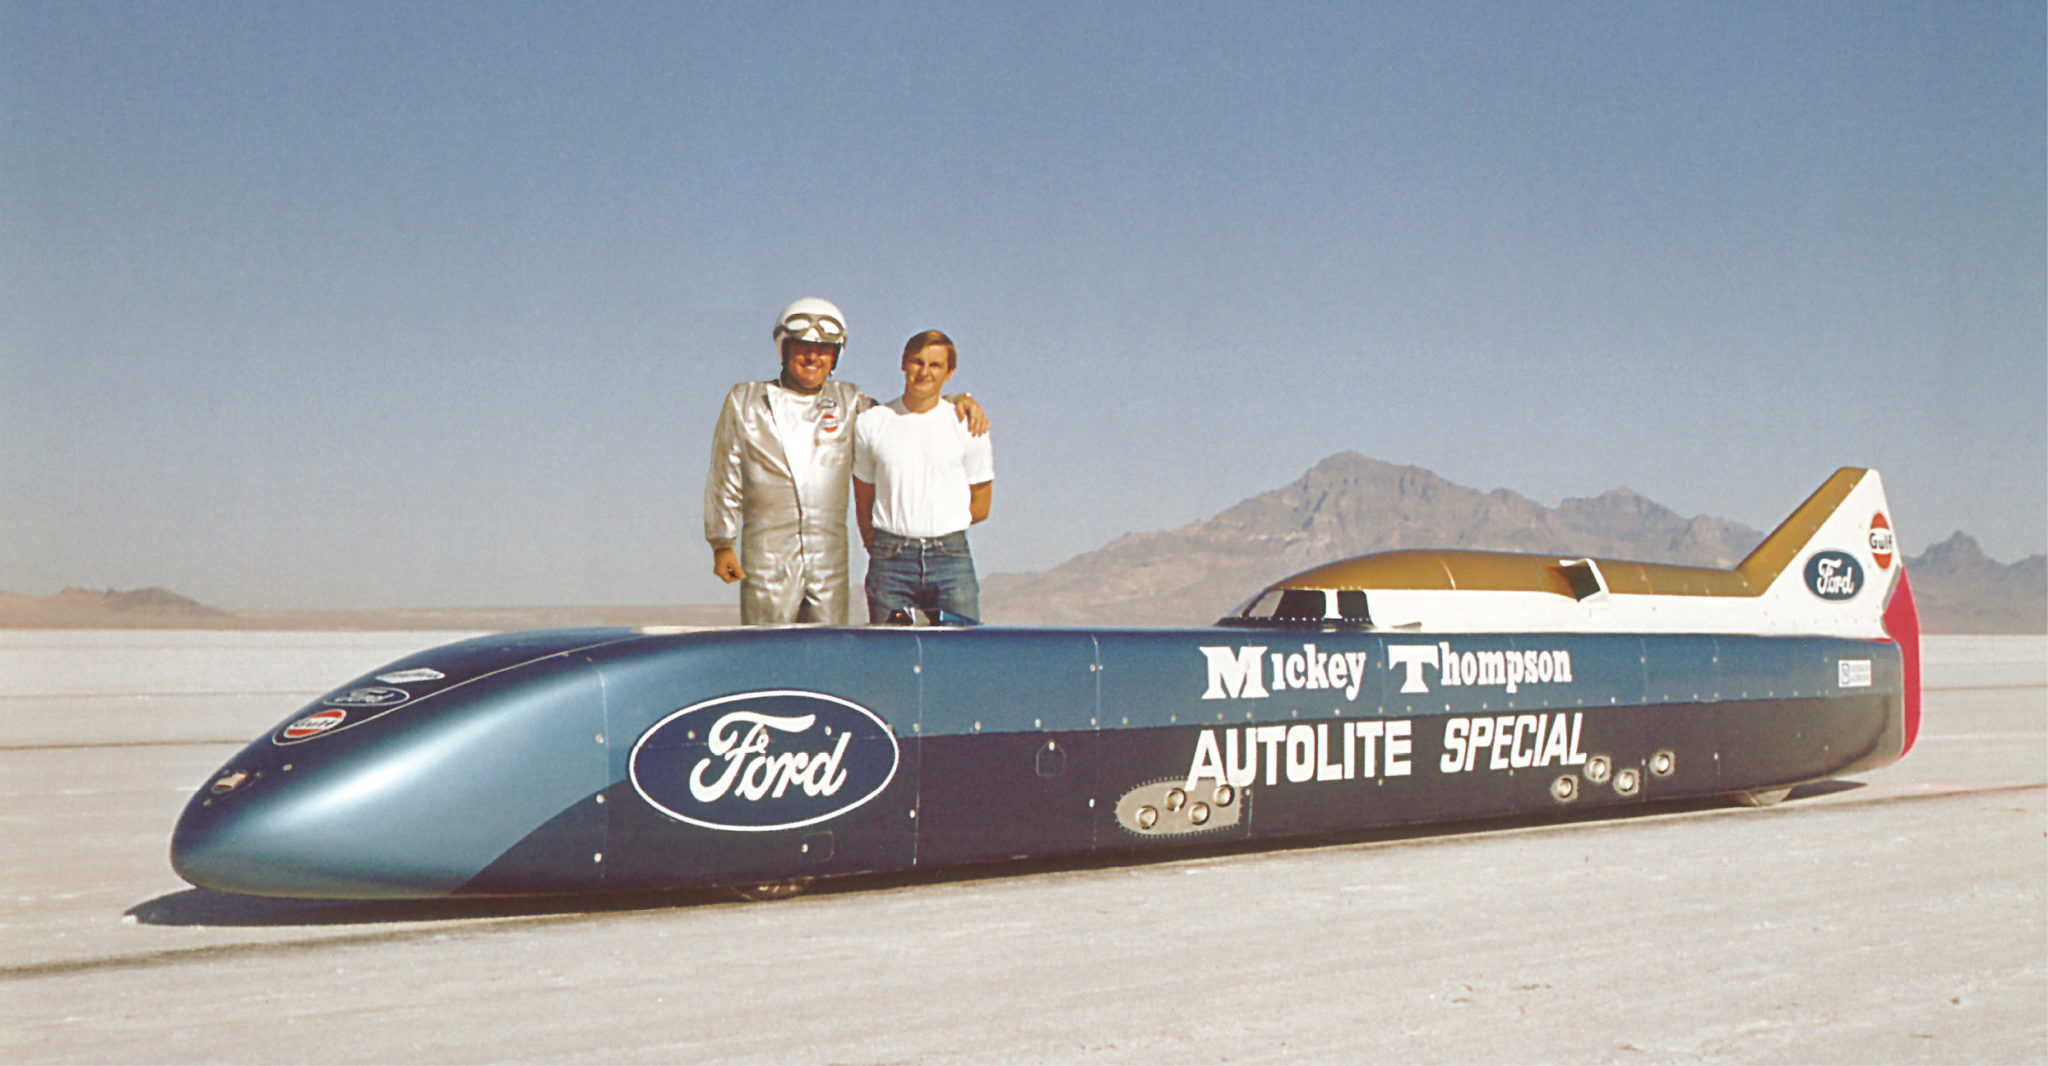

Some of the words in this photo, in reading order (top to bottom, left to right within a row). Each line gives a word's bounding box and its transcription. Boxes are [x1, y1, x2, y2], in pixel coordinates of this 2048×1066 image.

[1868, 532, 1893, 550] Gulf
[1817, 558, 1854, 594] Ford
[1200, 643, 1366, 701] Mickey
[1389, 641, 1572, 693] Thompson
[690, 711, 851, 802] Ford
[1185, 720, 1412, 790] AUTOLITE
[1441, 712, 1587, 773] SPECIAL
